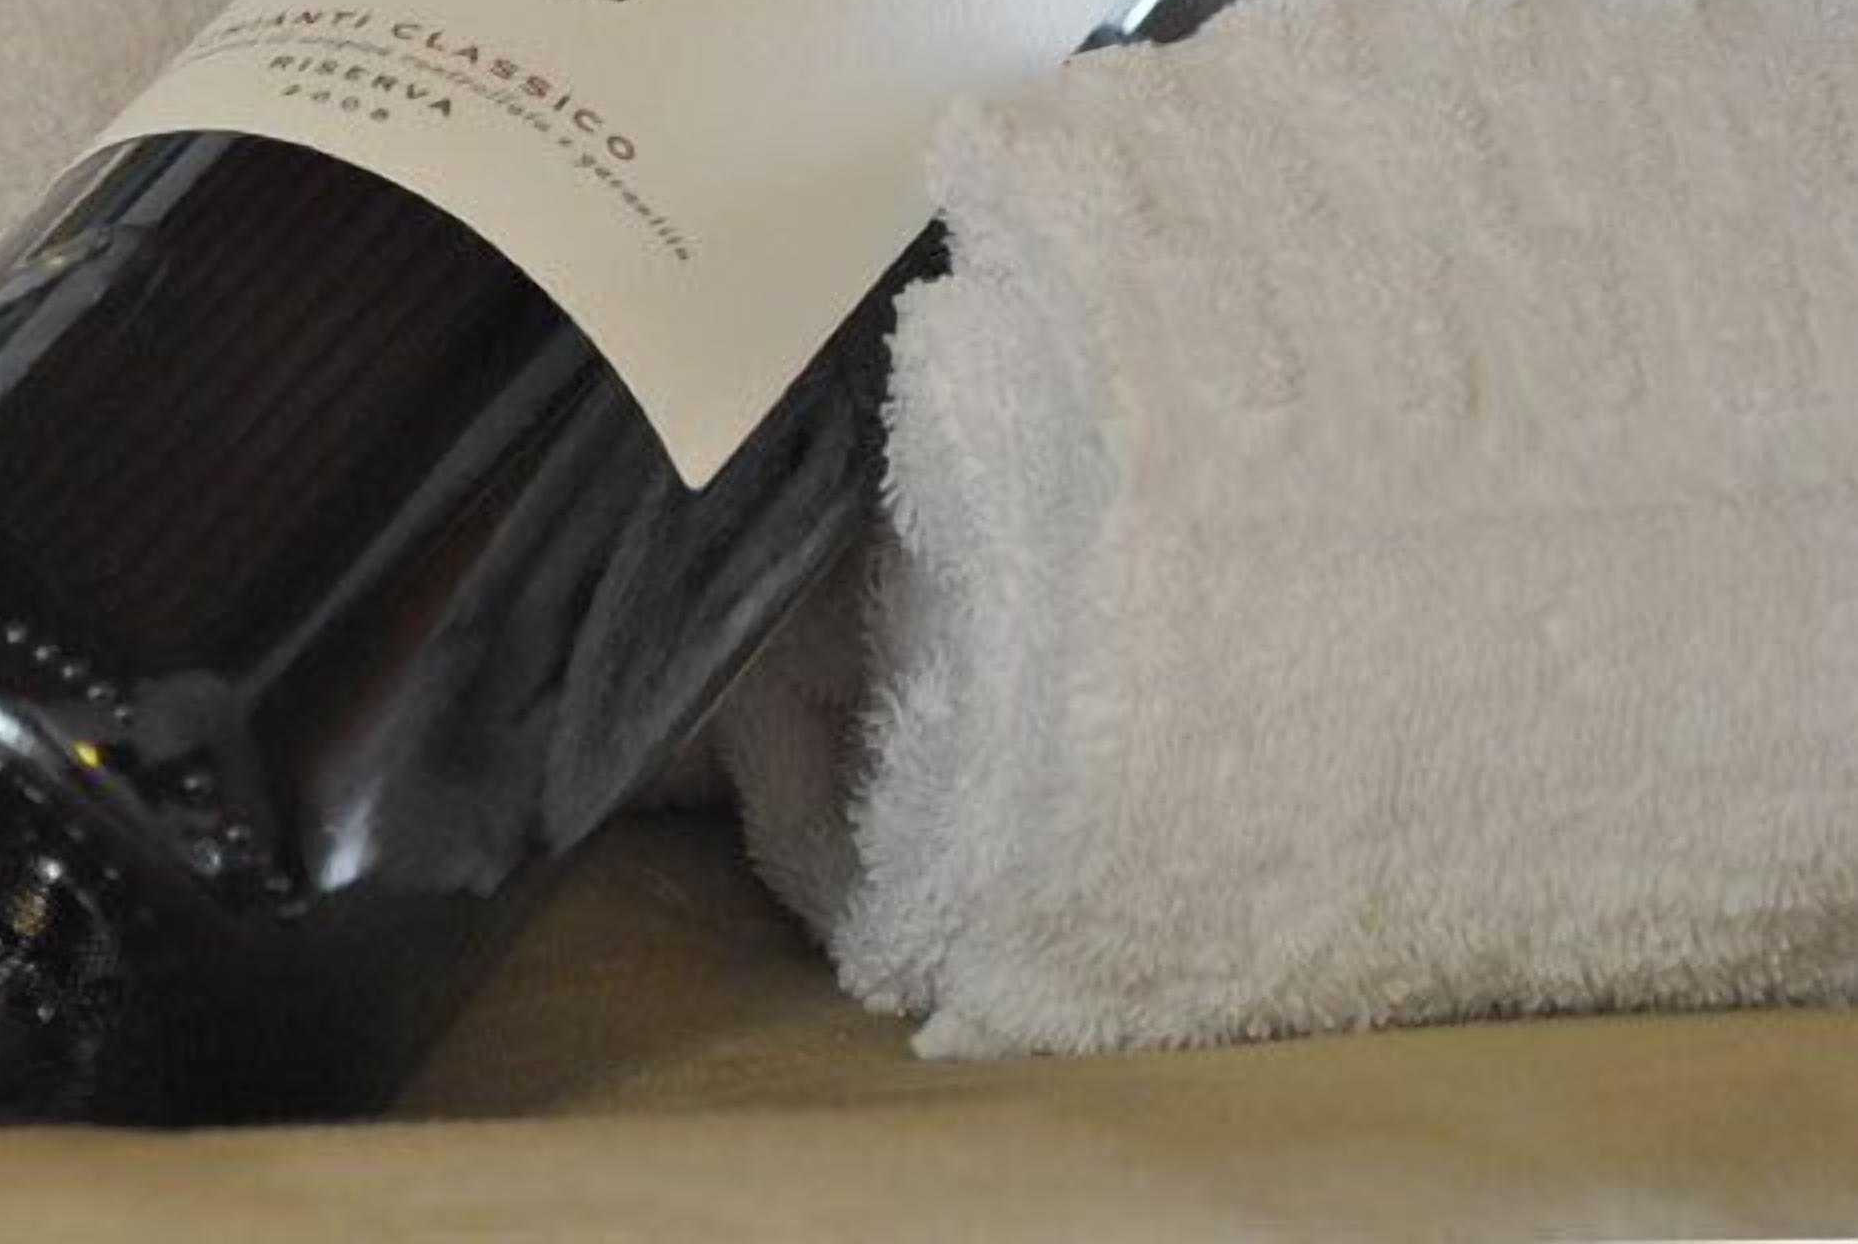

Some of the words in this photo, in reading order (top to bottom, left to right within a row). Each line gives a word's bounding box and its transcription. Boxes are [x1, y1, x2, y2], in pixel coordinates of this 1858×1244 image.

[197, 9, 372, 49] IANTI
[391, 22, 637, 161] CLASSICO
[267, 55, 451, 118] RISERVA
